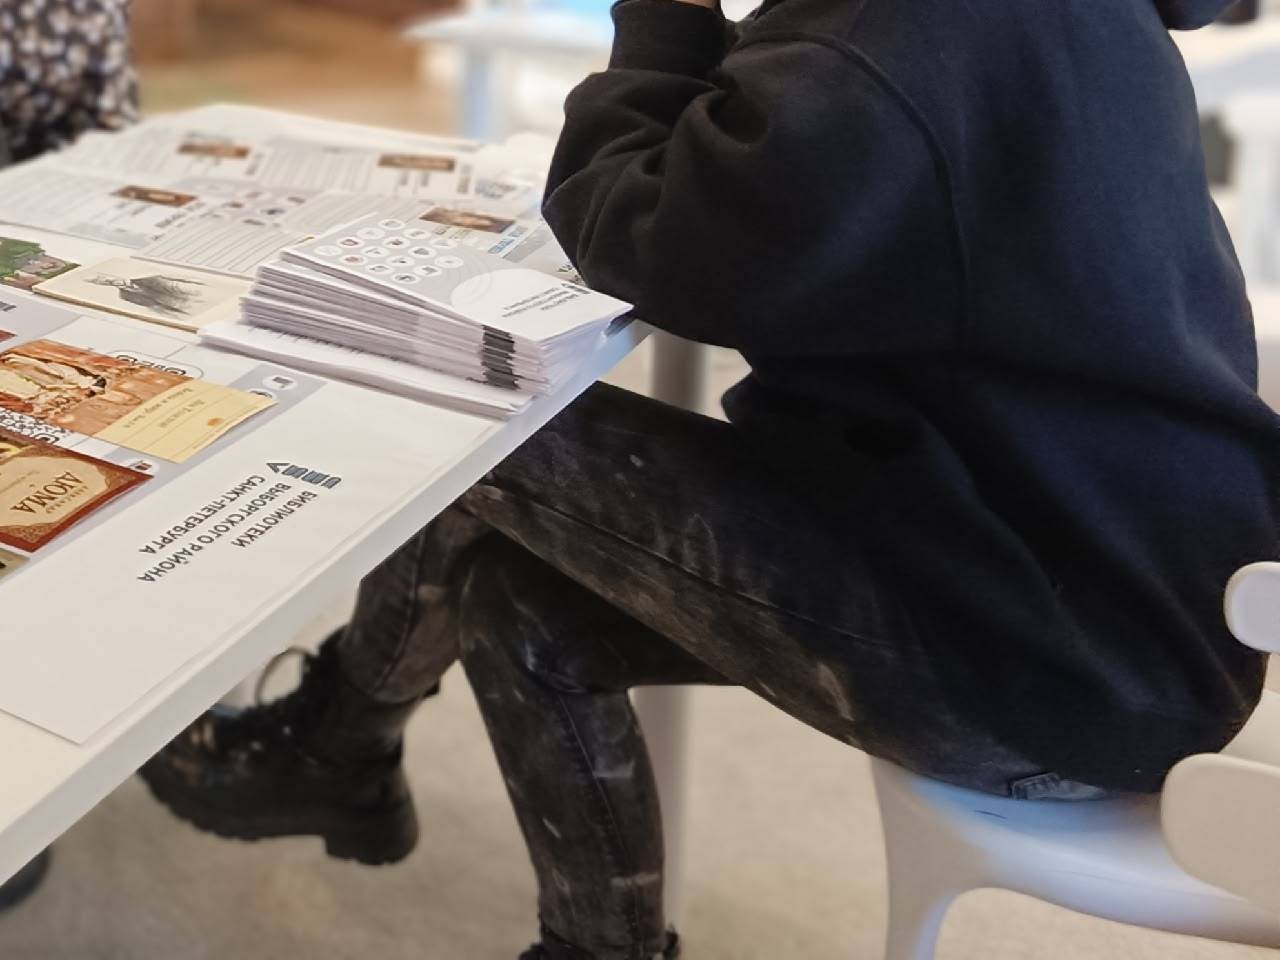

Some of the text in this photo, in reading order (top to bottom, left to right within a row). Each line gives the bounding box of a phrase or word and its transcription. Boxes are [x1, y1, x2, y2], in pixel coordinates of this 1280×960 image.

[6, 470, 89, 518] ДЮМА
[137, 473, 268, 558] САНКТ-ПЕТЕРБУРГА
[228, 489, 320, 549] БИБЛИОТЕКИ
[136, 481, 293, 589] ВЫБОРГСКОГО РАЙОНА
